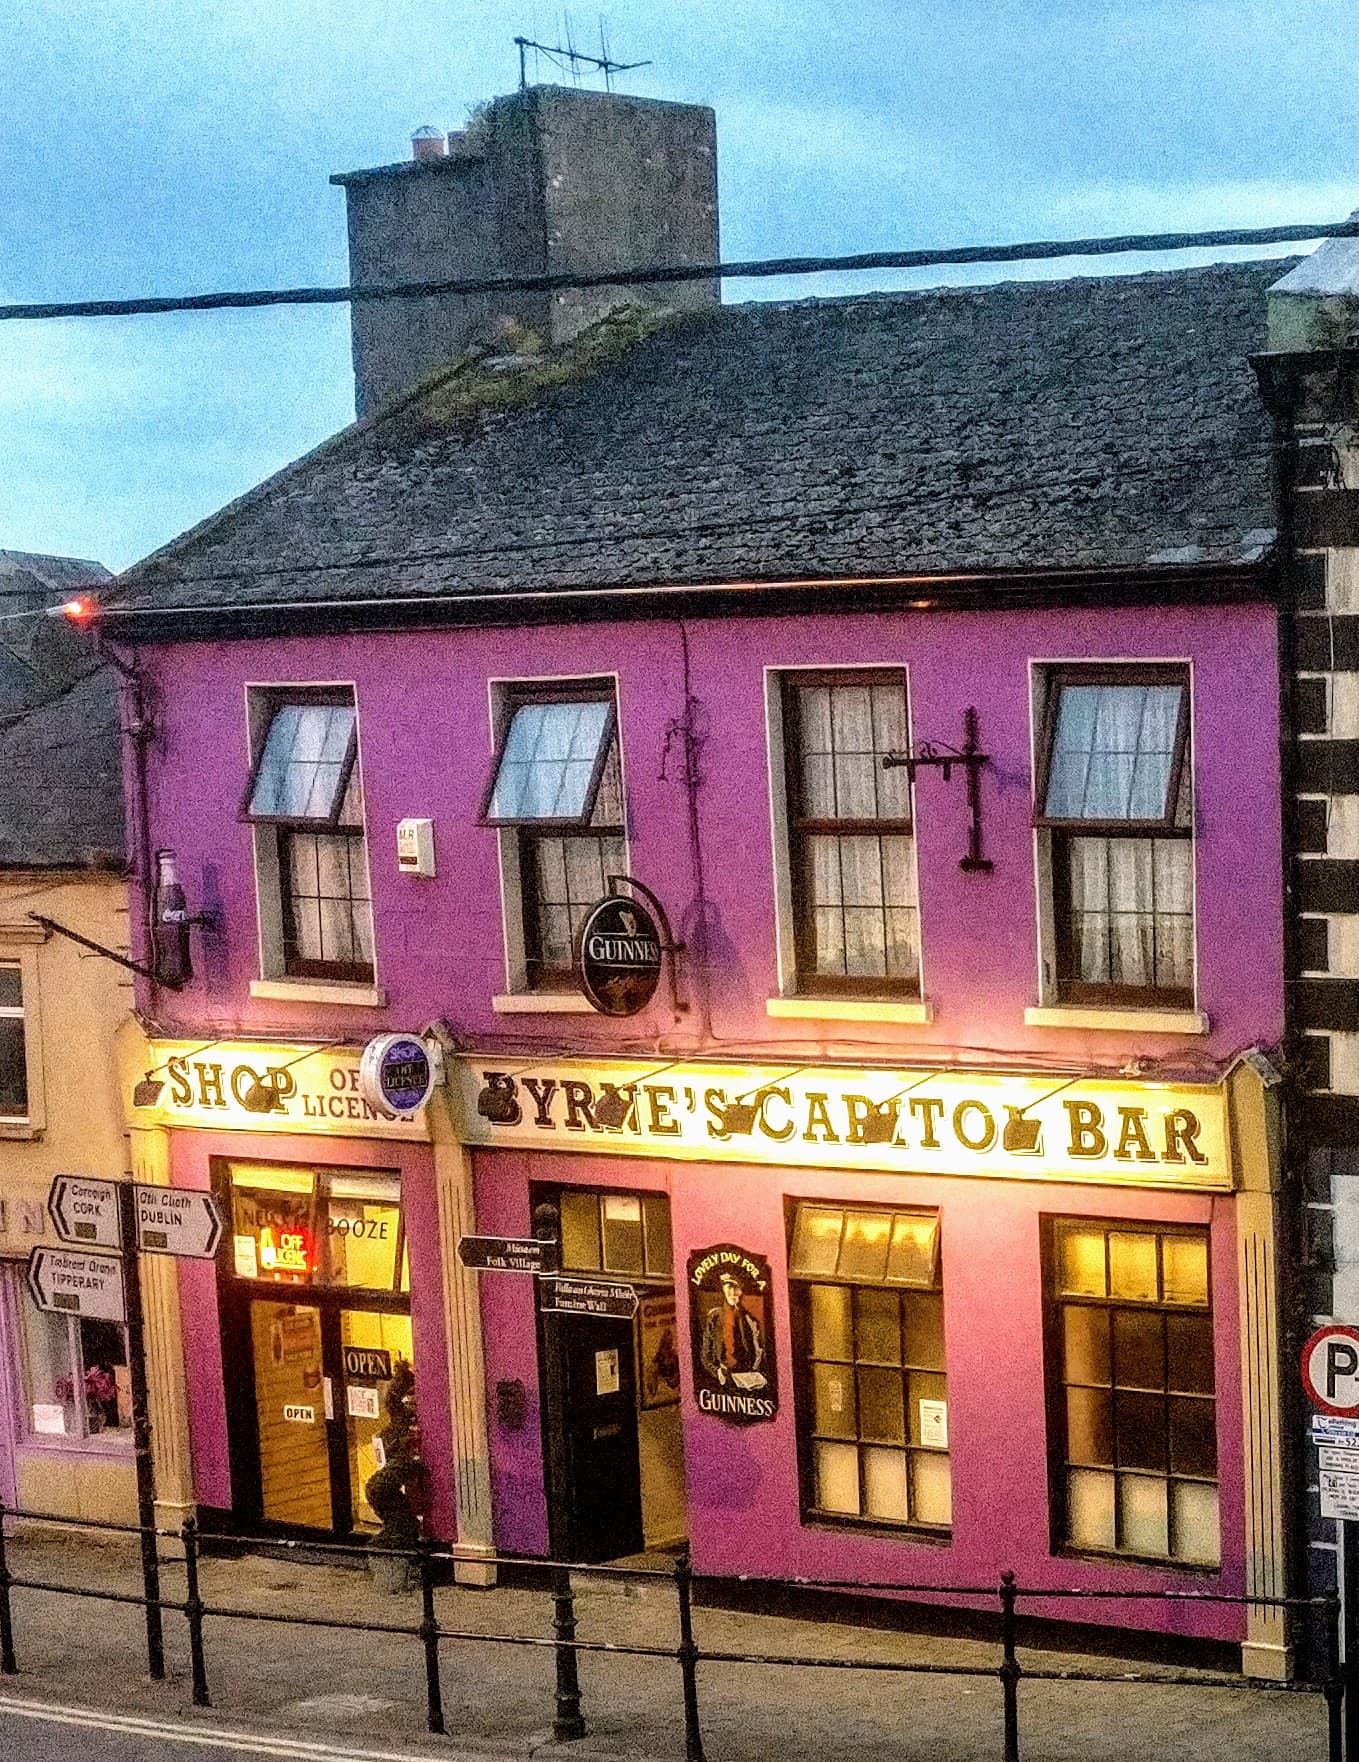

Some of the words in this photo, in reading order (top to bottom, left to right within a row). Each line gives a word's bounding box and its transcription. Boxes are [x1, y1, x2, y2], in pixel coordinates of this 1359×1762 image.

[167, 1056, 296, 1113] SHOP
[330, 1067, 360, 1092] OF
[1063, 1100, 1207, 1165] BAR
[73, 1202, 102, 1216] CORK
[141, 1209, 182, 1225] DUBLIN
[326, 1217, 388, 1240] BOOZE
[281, 1234, 304, 1249] OFF
[486, 1256, 507, 1268] Folk
[508, 1257, 541, 1271] Village
[691, 1252, 720, 1287] LOVELY
[720, 1251, 741, 1264] DAY
[741, 1257, 761, 1279] FOR
[756, 1280, 767, 1291] A
[52, 1272, 105, 1290] TIPPERARY
[347, 1351, 388, 1376] OPEN
[1326, 1342, 1358, 1398] P
[286, 1407, 312, 1419] OPEN
[699, 1388, 777, 1417] GUINNESS
